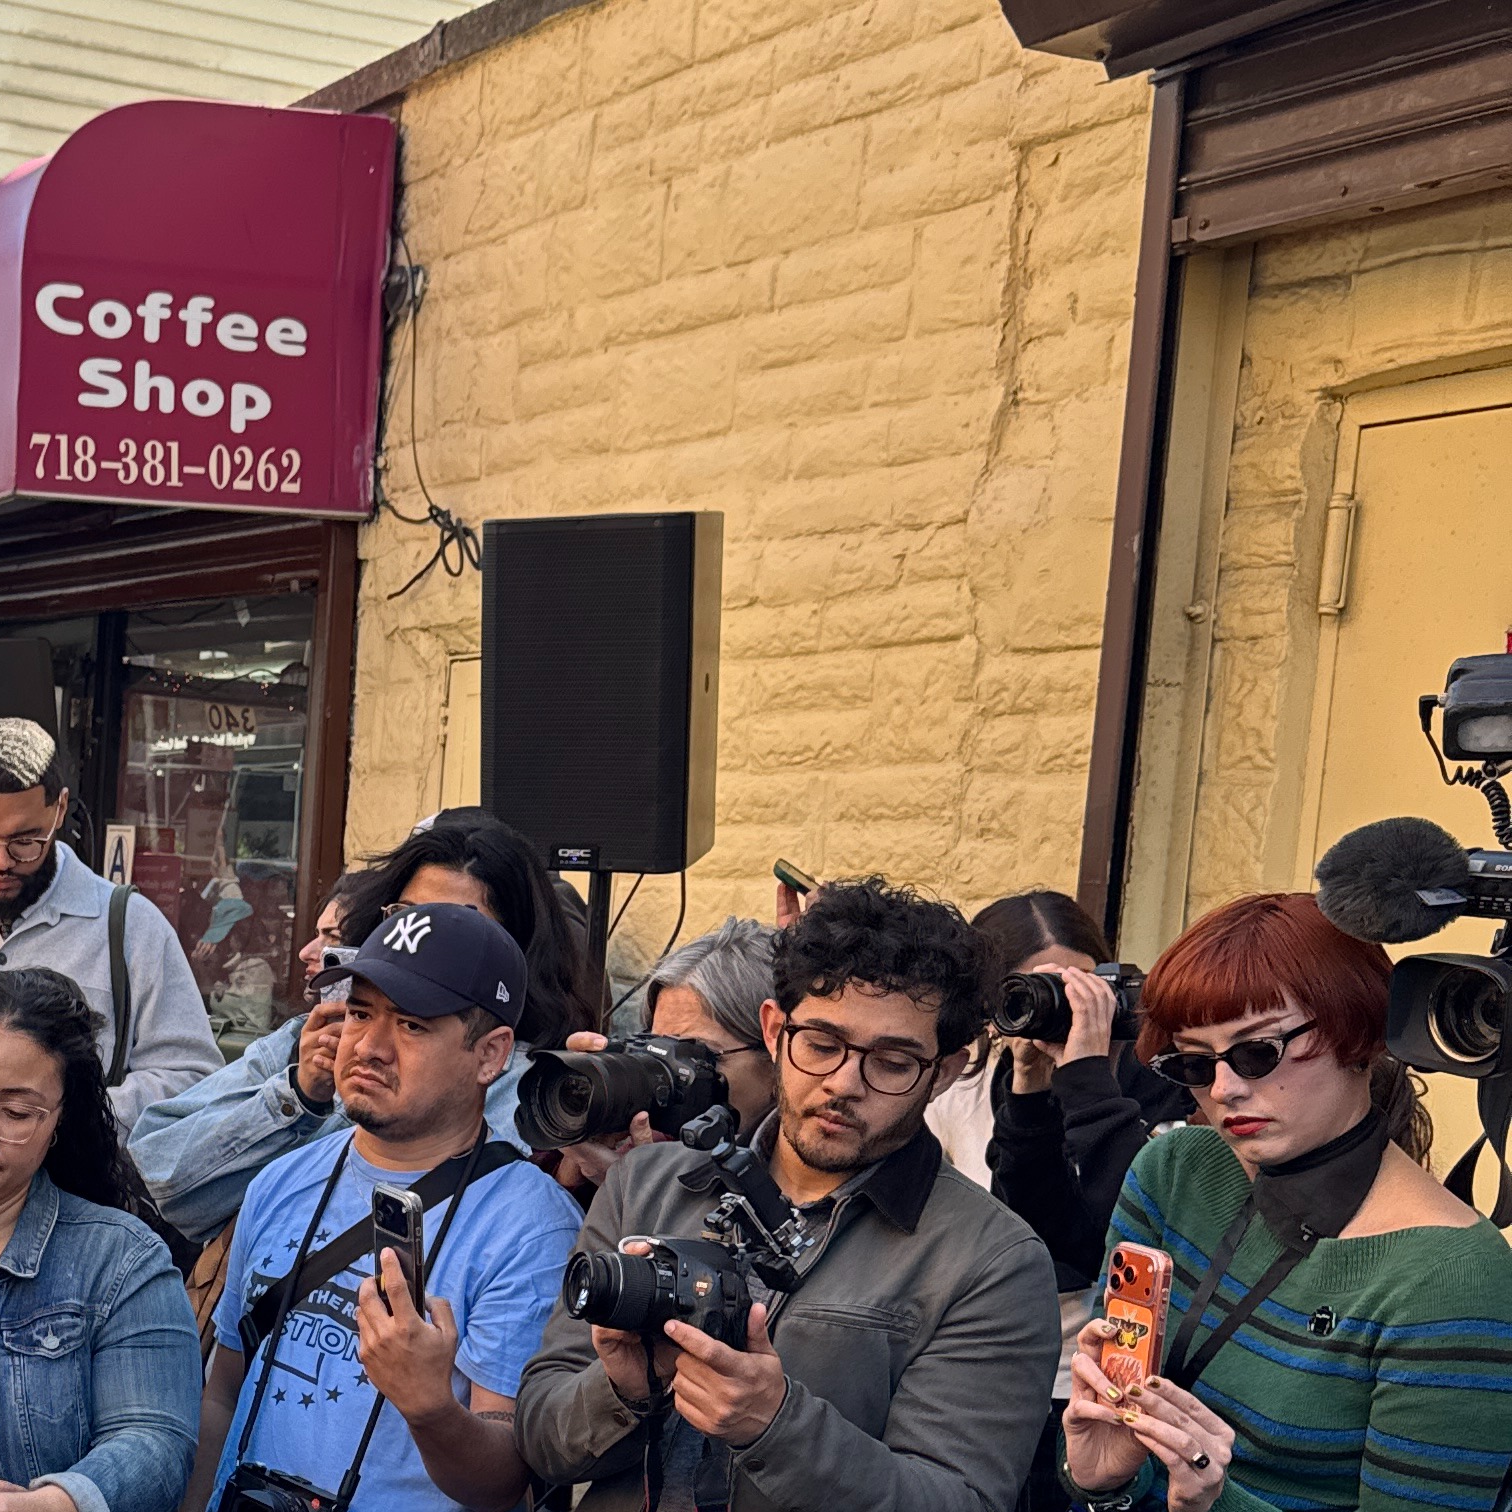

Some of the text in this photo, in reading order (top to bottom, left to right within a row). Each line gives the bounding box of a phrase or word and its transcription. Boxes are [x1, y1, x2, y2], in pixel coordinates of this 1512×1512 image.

[35, 283, 308, 357] Coffee
[77, 357, 272, 433] Shop
[29, 433, 302, 494] 718-381-0262
